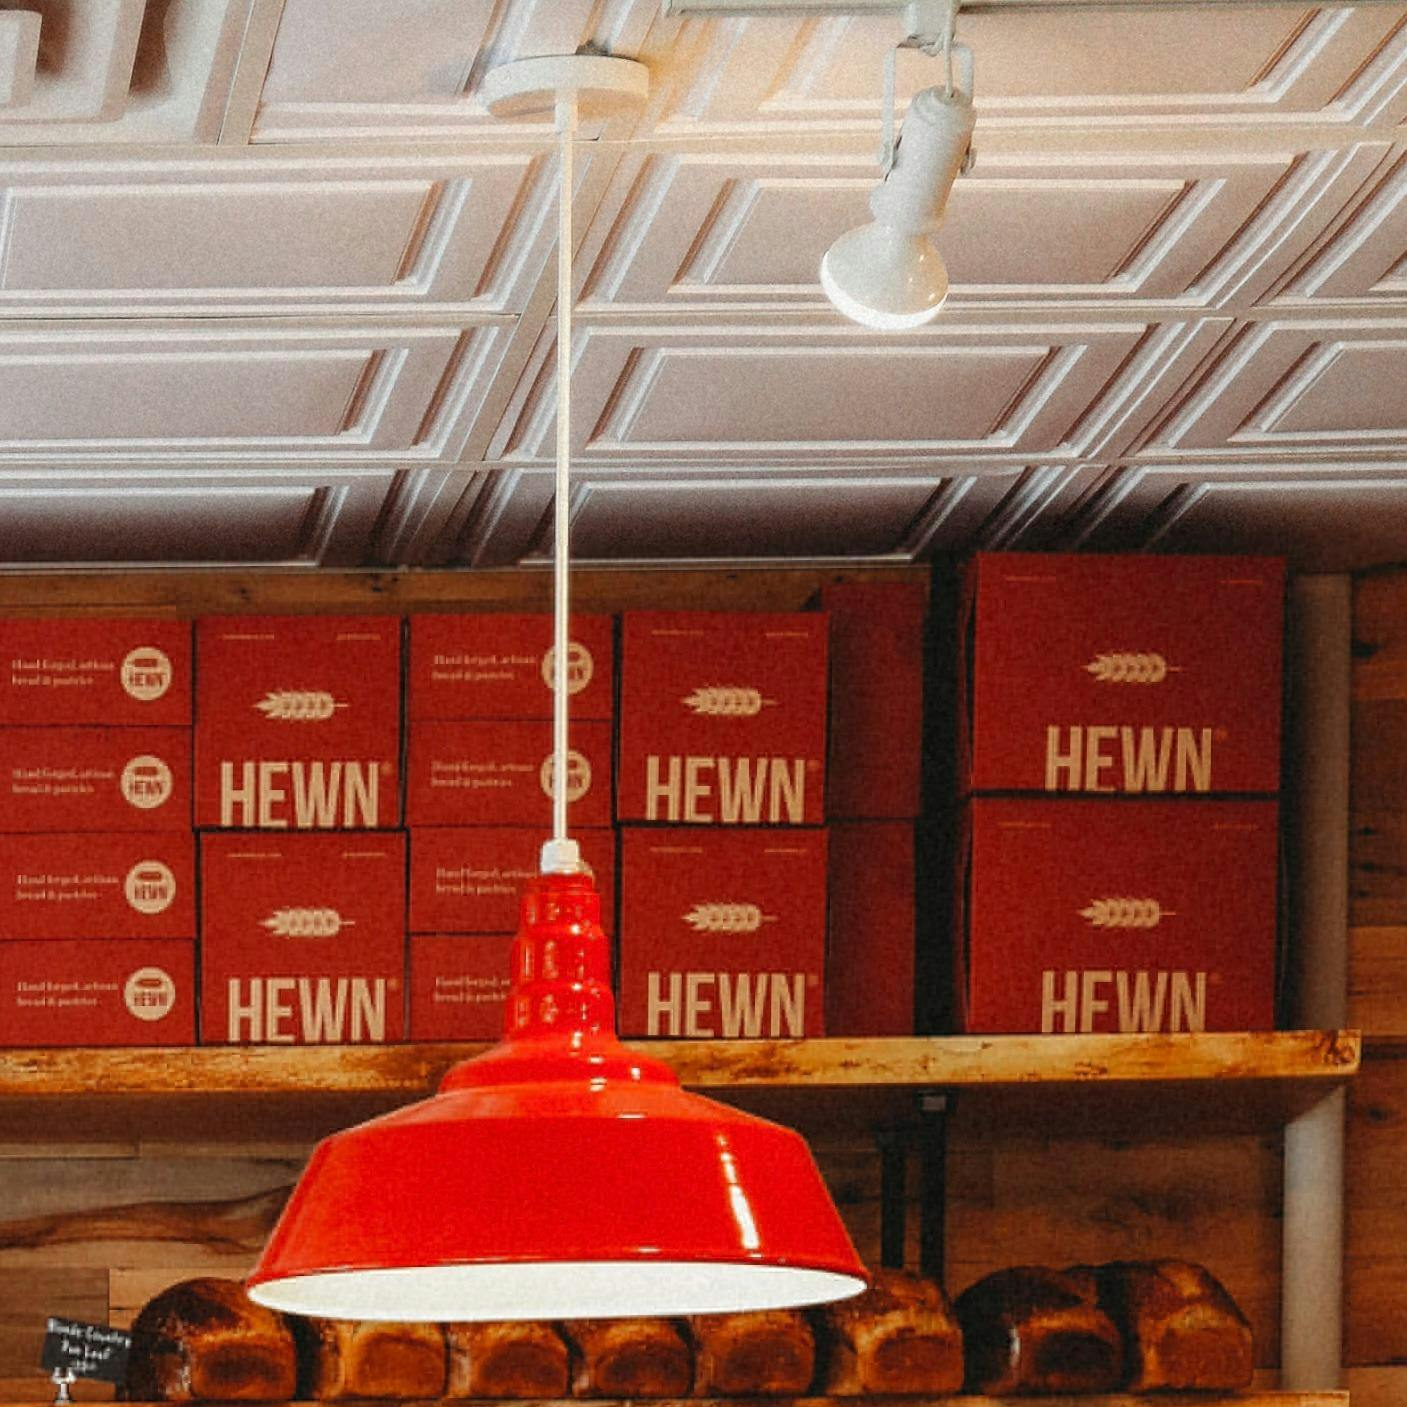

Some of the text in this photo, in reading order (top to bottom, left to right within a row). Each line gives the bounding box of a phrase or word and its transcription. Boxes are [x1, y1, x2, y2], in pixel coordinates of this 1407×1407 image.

[647, 757, 804, 822] HEWN
[1046, 727, 1211, 790] HEWN
[221, 762, 378, 827] HEWN
[229, 978, 384, 1043] HEWN
[648, 973, 804, 1037] HEWN
[1042, 972, 1205, 1032] HEWN
